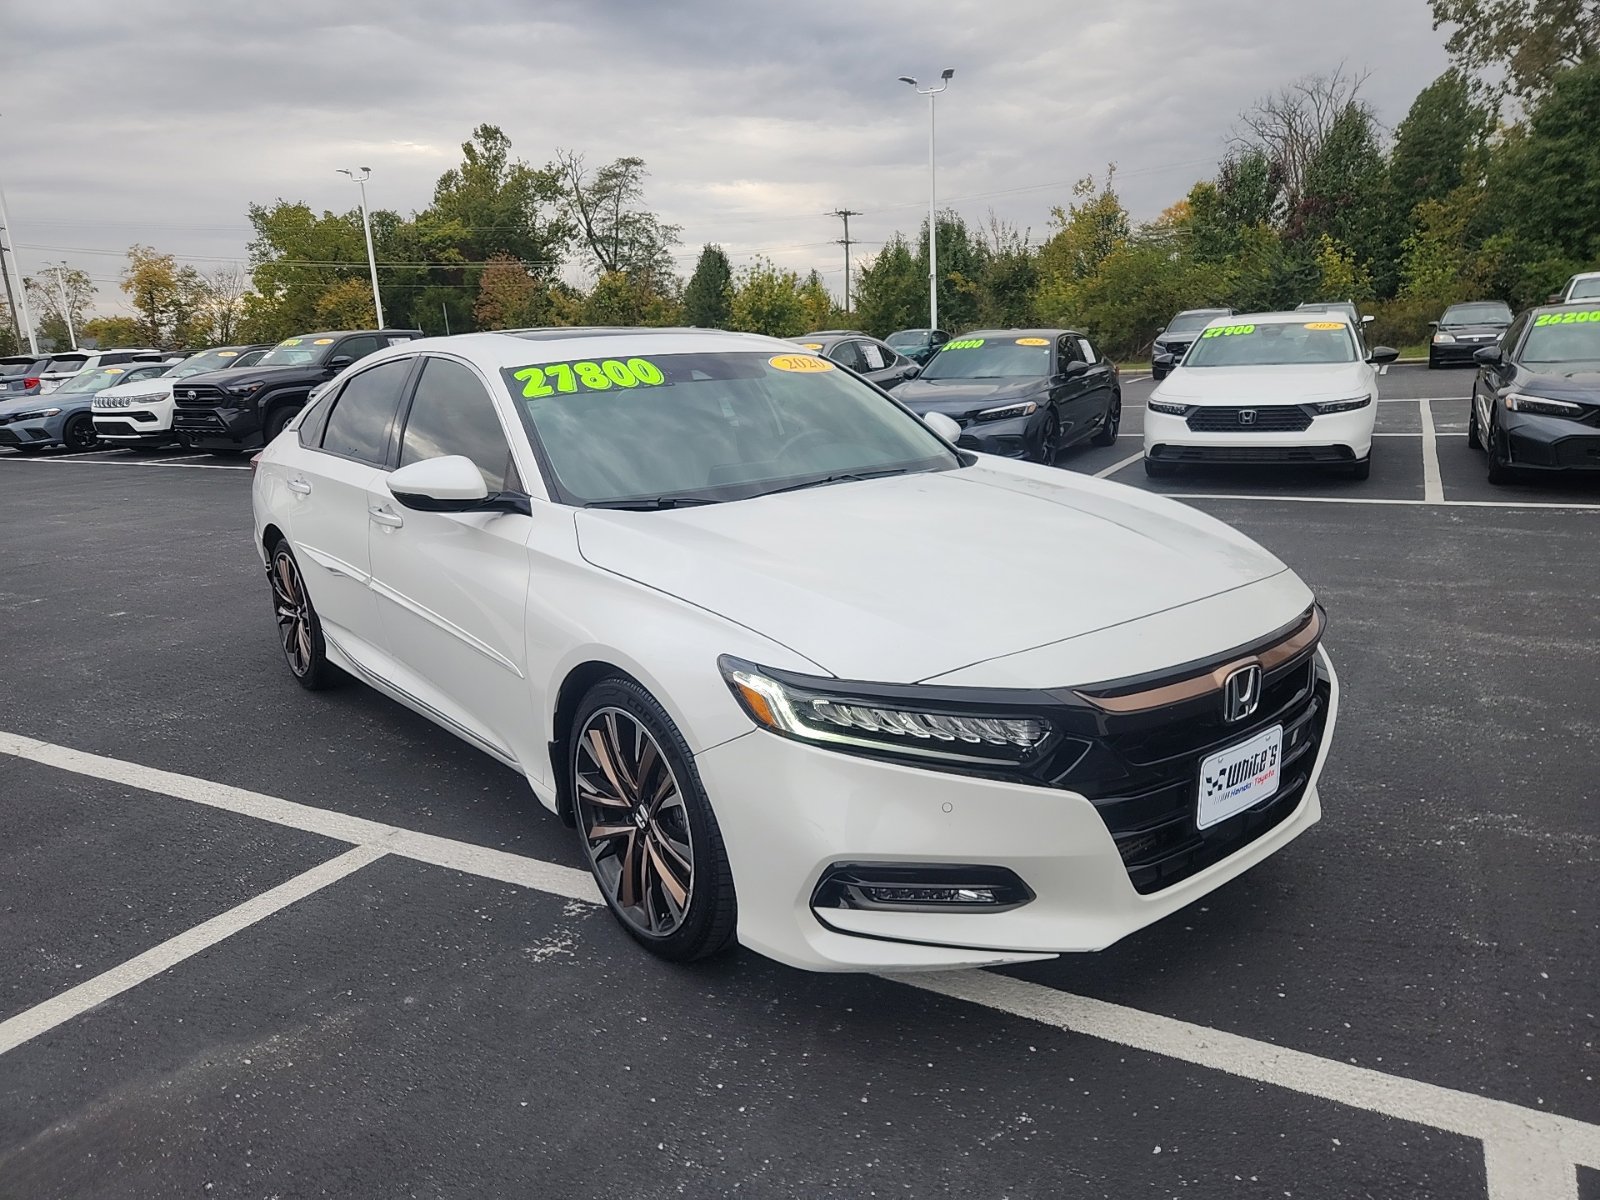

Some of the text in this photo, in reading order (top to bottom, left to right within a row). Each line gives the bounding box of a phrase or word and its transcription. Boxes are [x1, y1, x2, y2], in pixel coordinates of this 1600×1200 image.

[1534, 311, 1600, 326] 26200
[1204, 324, 1255, 338] 27900
[782, 357, 826, 370] 2020
[514, 358, 664, 398] 27800
[1254, 770, 1275, 785] Toyota
